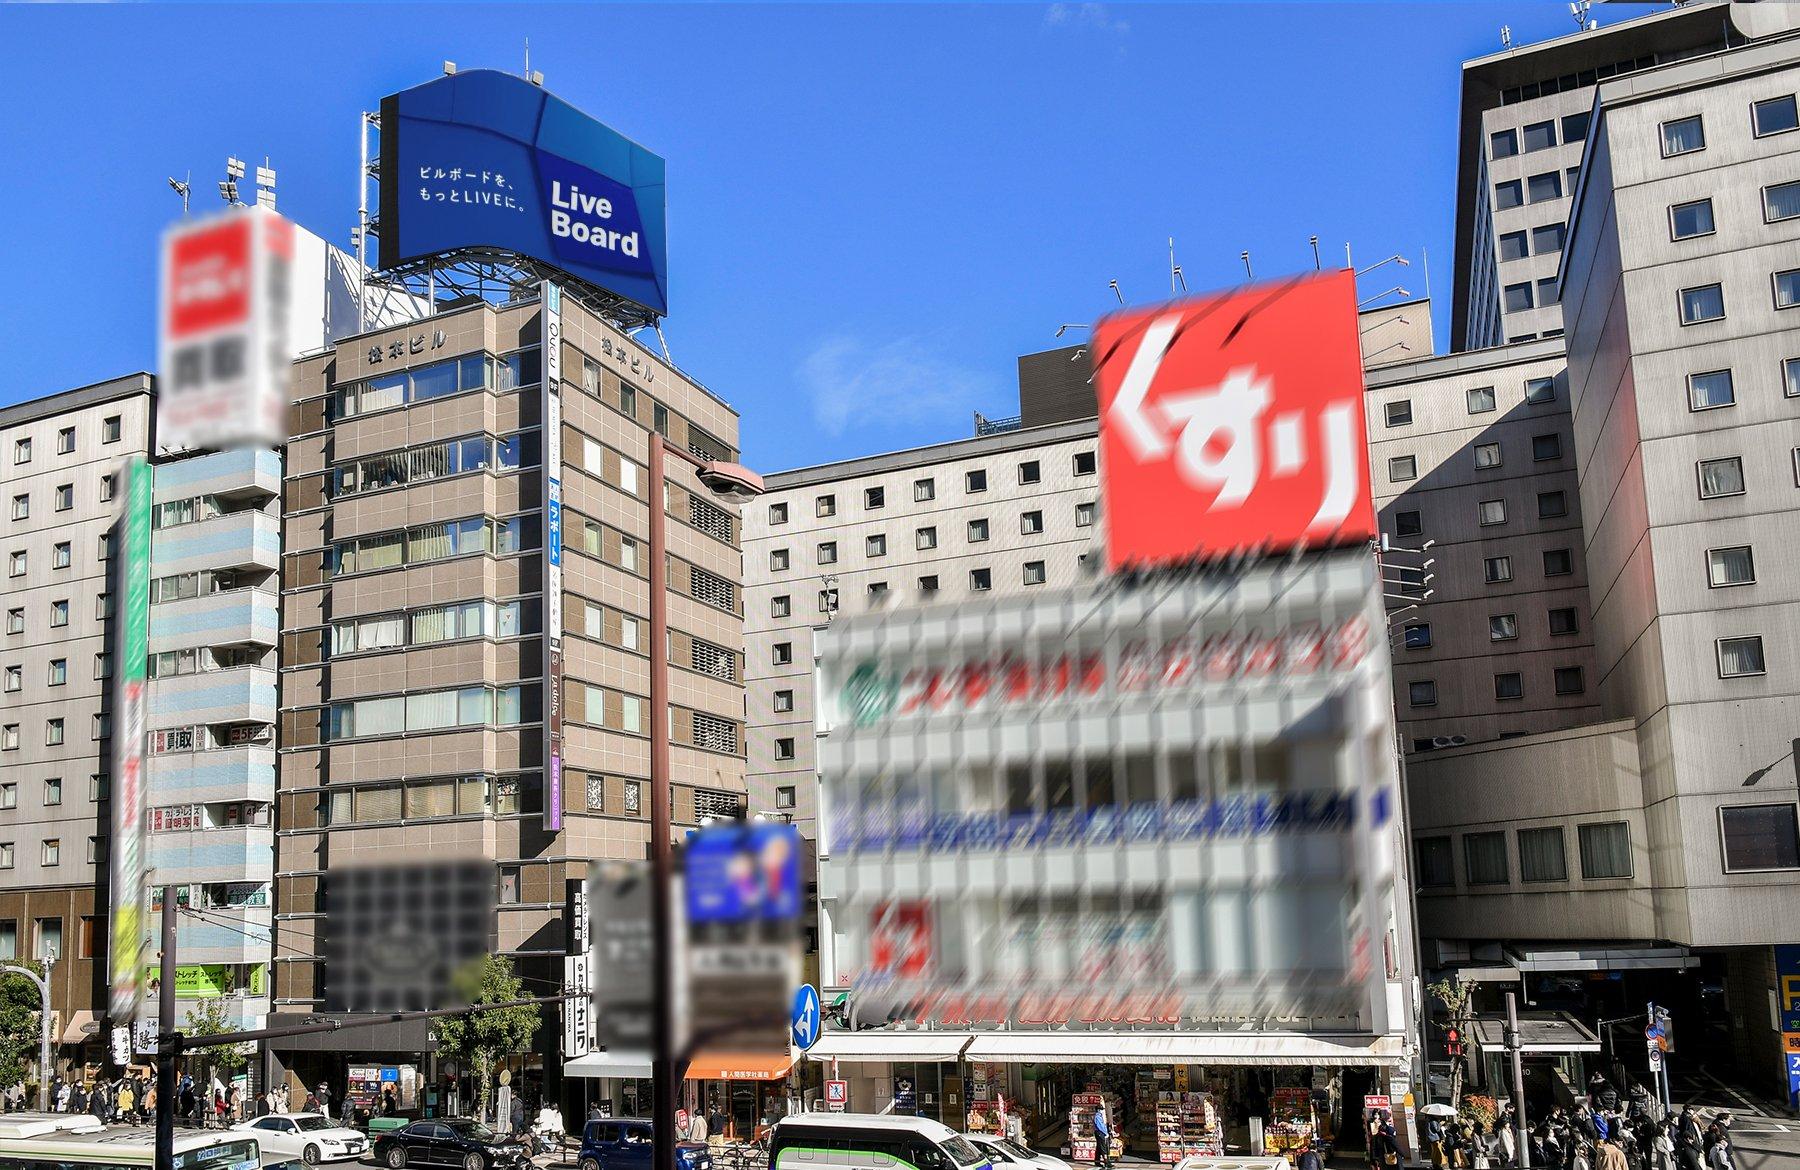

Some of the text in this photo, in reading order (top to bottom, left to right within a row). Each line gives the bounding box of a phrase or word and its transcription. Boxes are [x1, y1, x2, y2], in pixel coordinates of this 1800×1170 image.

[419, 166, 514, 190] ビルボードを、
[419, 187, 525, 212] もっとLIVEに。
[552, 180, 612, 219] Live
[551, 209, 639, 258] Board
[368, 329, 449, 364] 松本ビル
[601, 336, 655, 383] 松本ビル
[1522, 1068, 1531, 1076] 10
